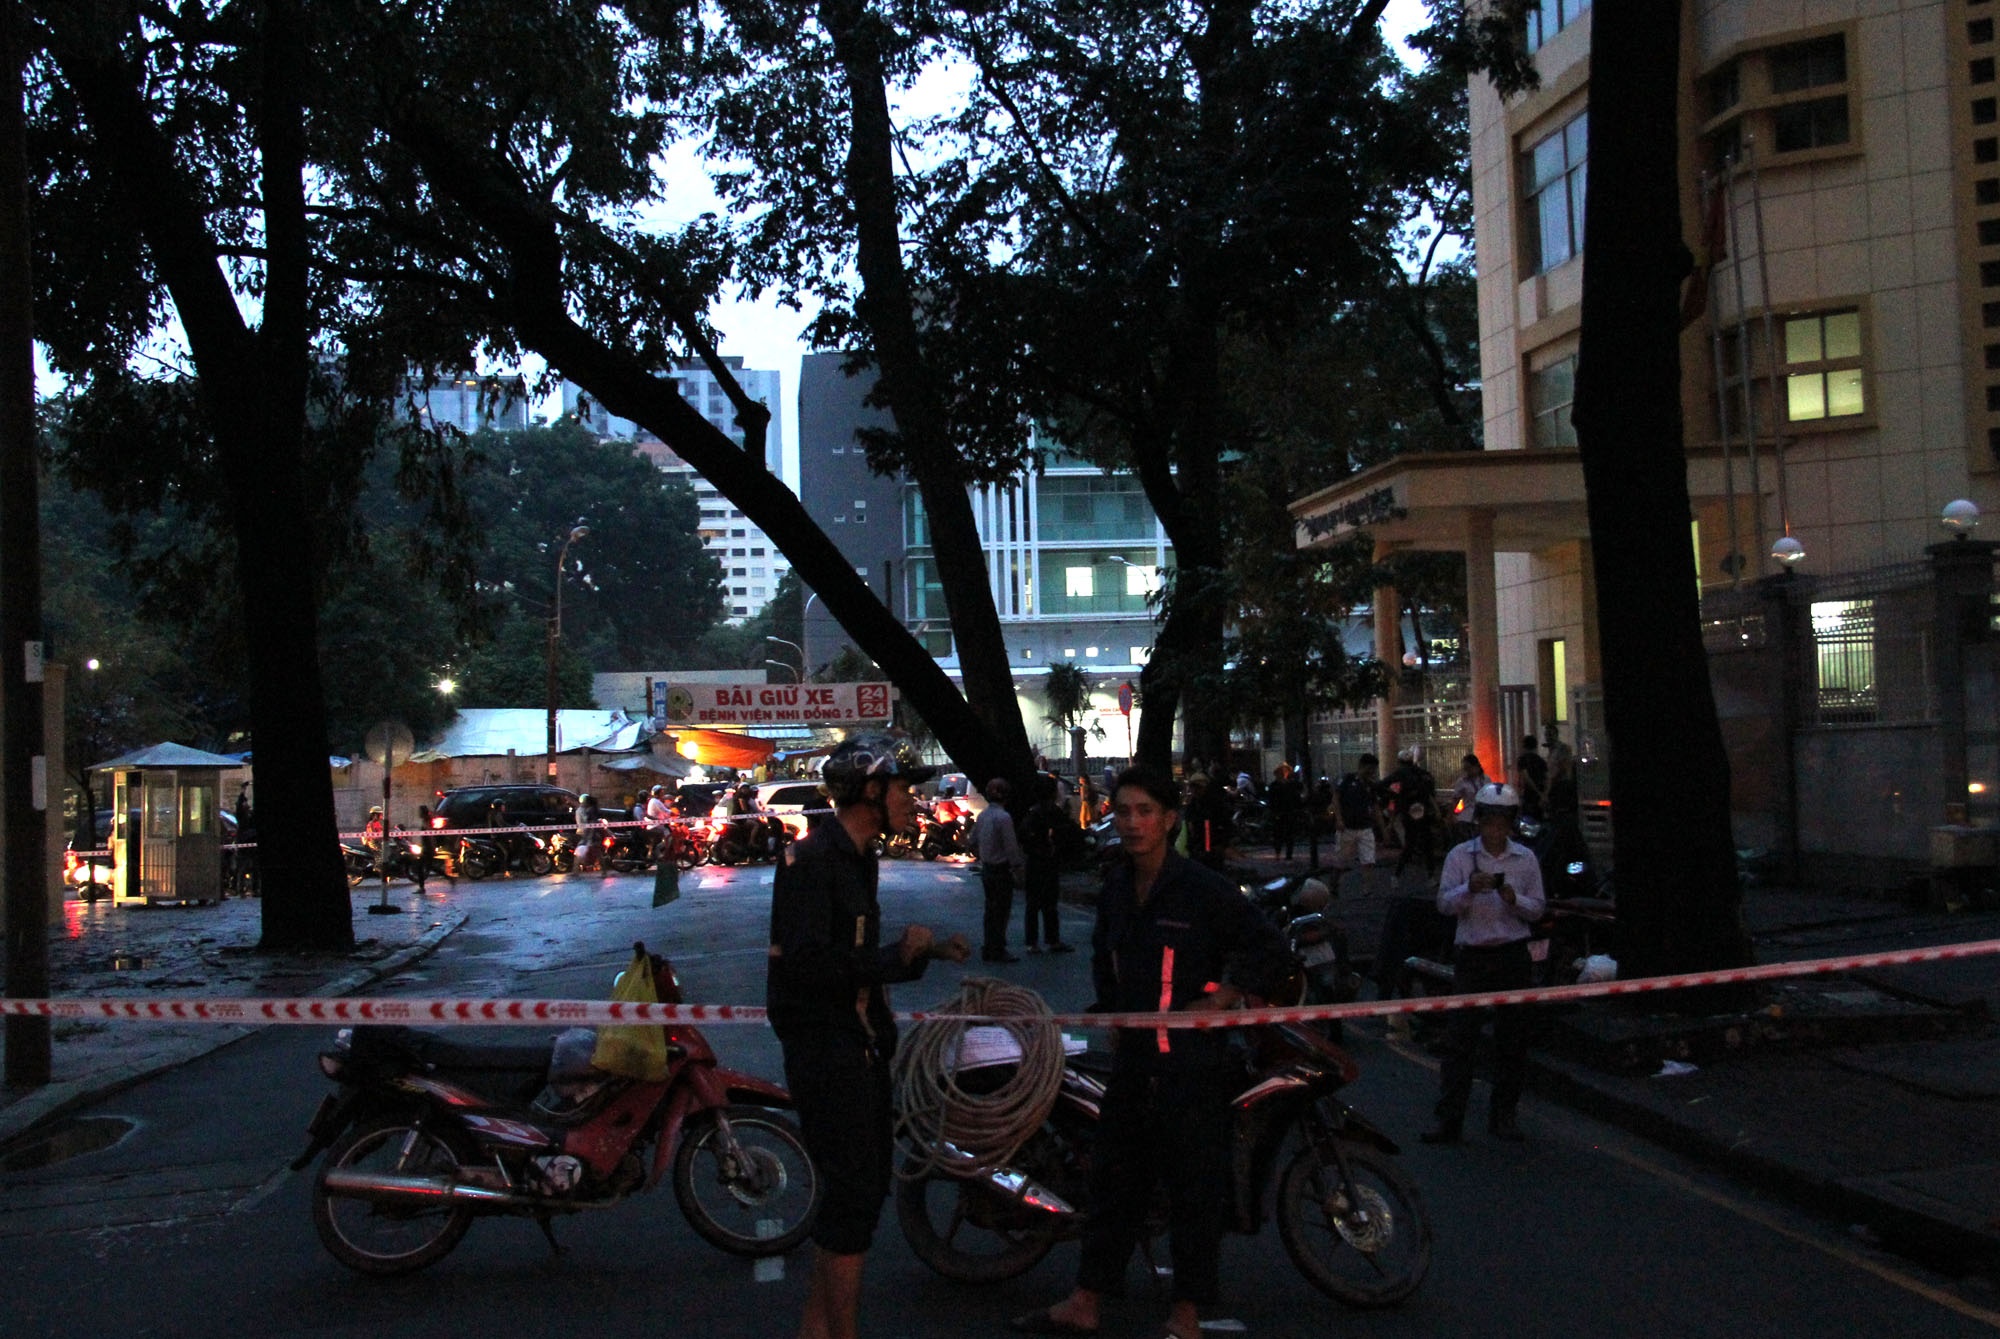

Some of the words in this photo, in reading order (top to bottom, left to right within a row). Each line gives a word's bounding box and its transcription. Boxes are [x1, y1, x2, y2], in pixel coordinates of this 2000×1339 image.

[716, 685, 752, 706] BÃI
[760, 685, 798, 706] GIỮ
[805, 689, 835, 705] XE
[861, 687, 884, 700] 24
[699, 708, 736, 723] BỆNH
[741, 708, 772, 723] VIỆN
[776, 709, 800, 720] NHI
[803, 706, 842, 719] ĐỒNG
[845, 709, 853, 718] 2
[862, 702, 885, 715] 24
